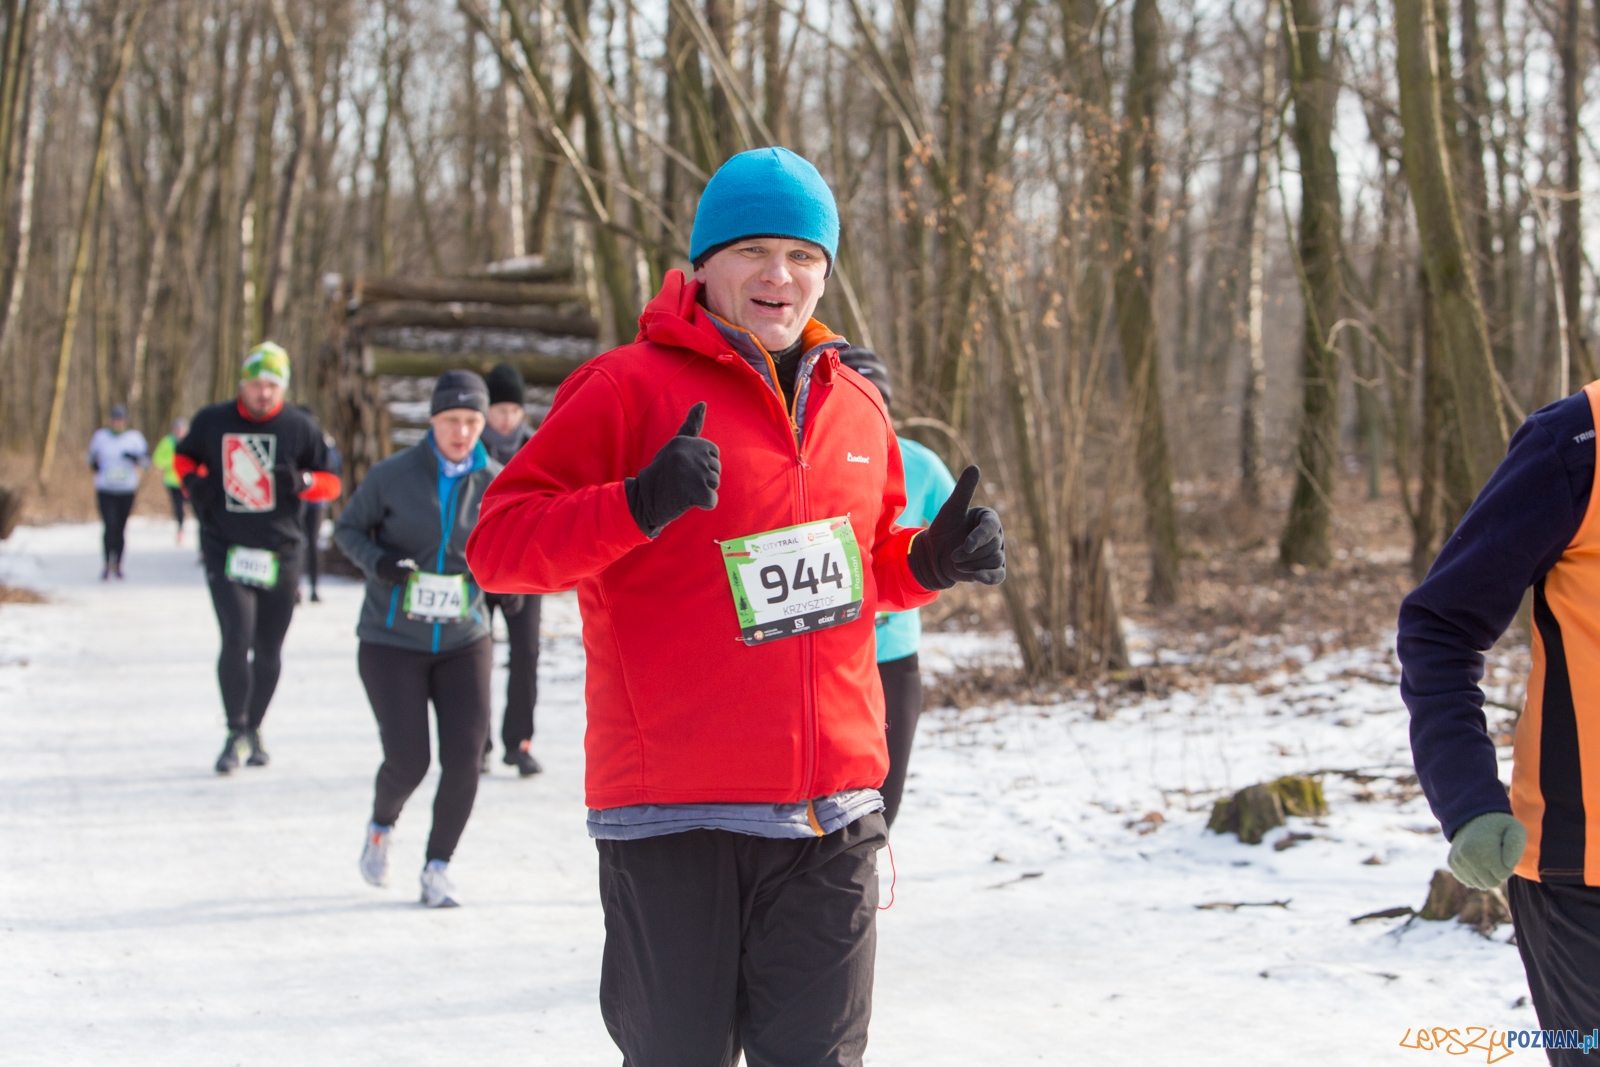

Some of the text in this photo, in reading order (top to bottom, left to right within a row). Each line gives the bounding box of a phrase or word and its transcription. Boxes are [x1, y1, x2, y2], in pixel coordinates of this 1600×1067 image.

[760, 552, 843, 605] 944
[850, 555, 861, 590] Poznań
[417, 587, 461, 608] 1374
[783, 595, 836, 616] KRZYSZTOF
